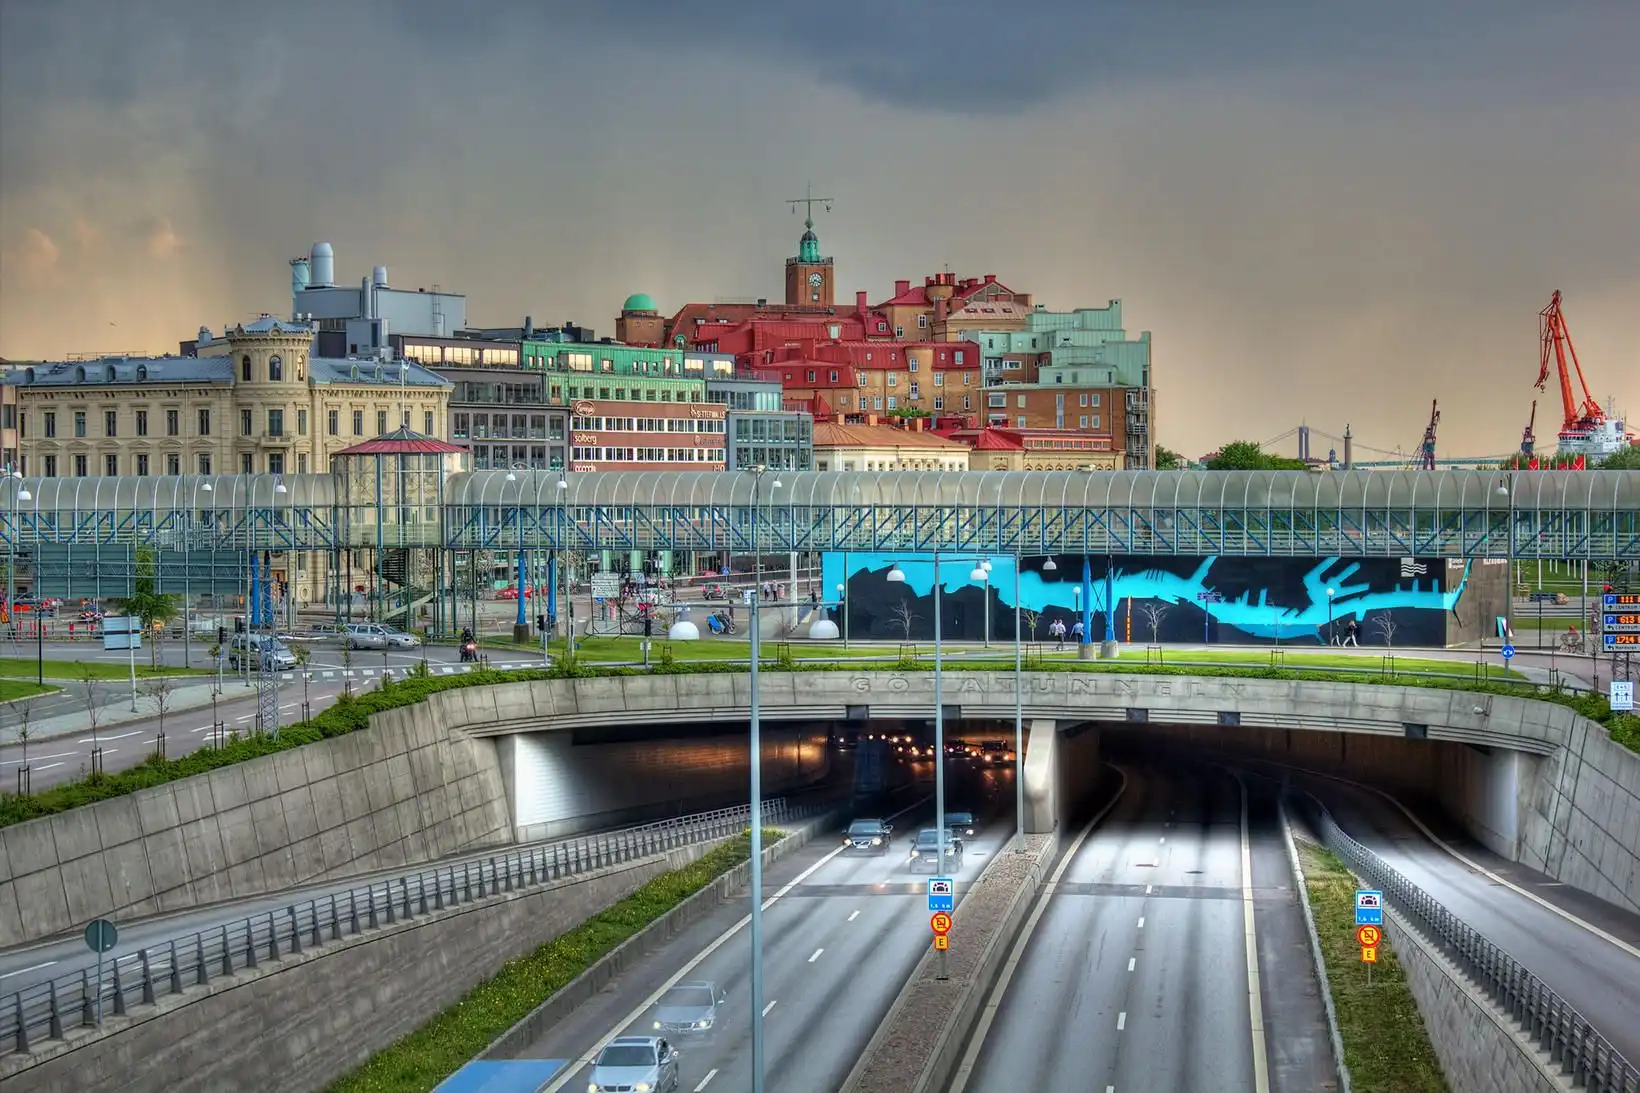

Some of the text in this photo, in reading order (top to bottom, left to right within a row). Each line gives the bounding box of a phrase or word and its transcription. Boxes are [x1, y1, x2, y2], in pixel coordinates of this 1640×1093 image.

[574, 434, 597, 445] solberg
[1620, 616, 1635, 624] 613
[1616, 636, 1635, 644] 1714
[938, 938, 944, 947] E
[1366, 950, 1371, 959] E
